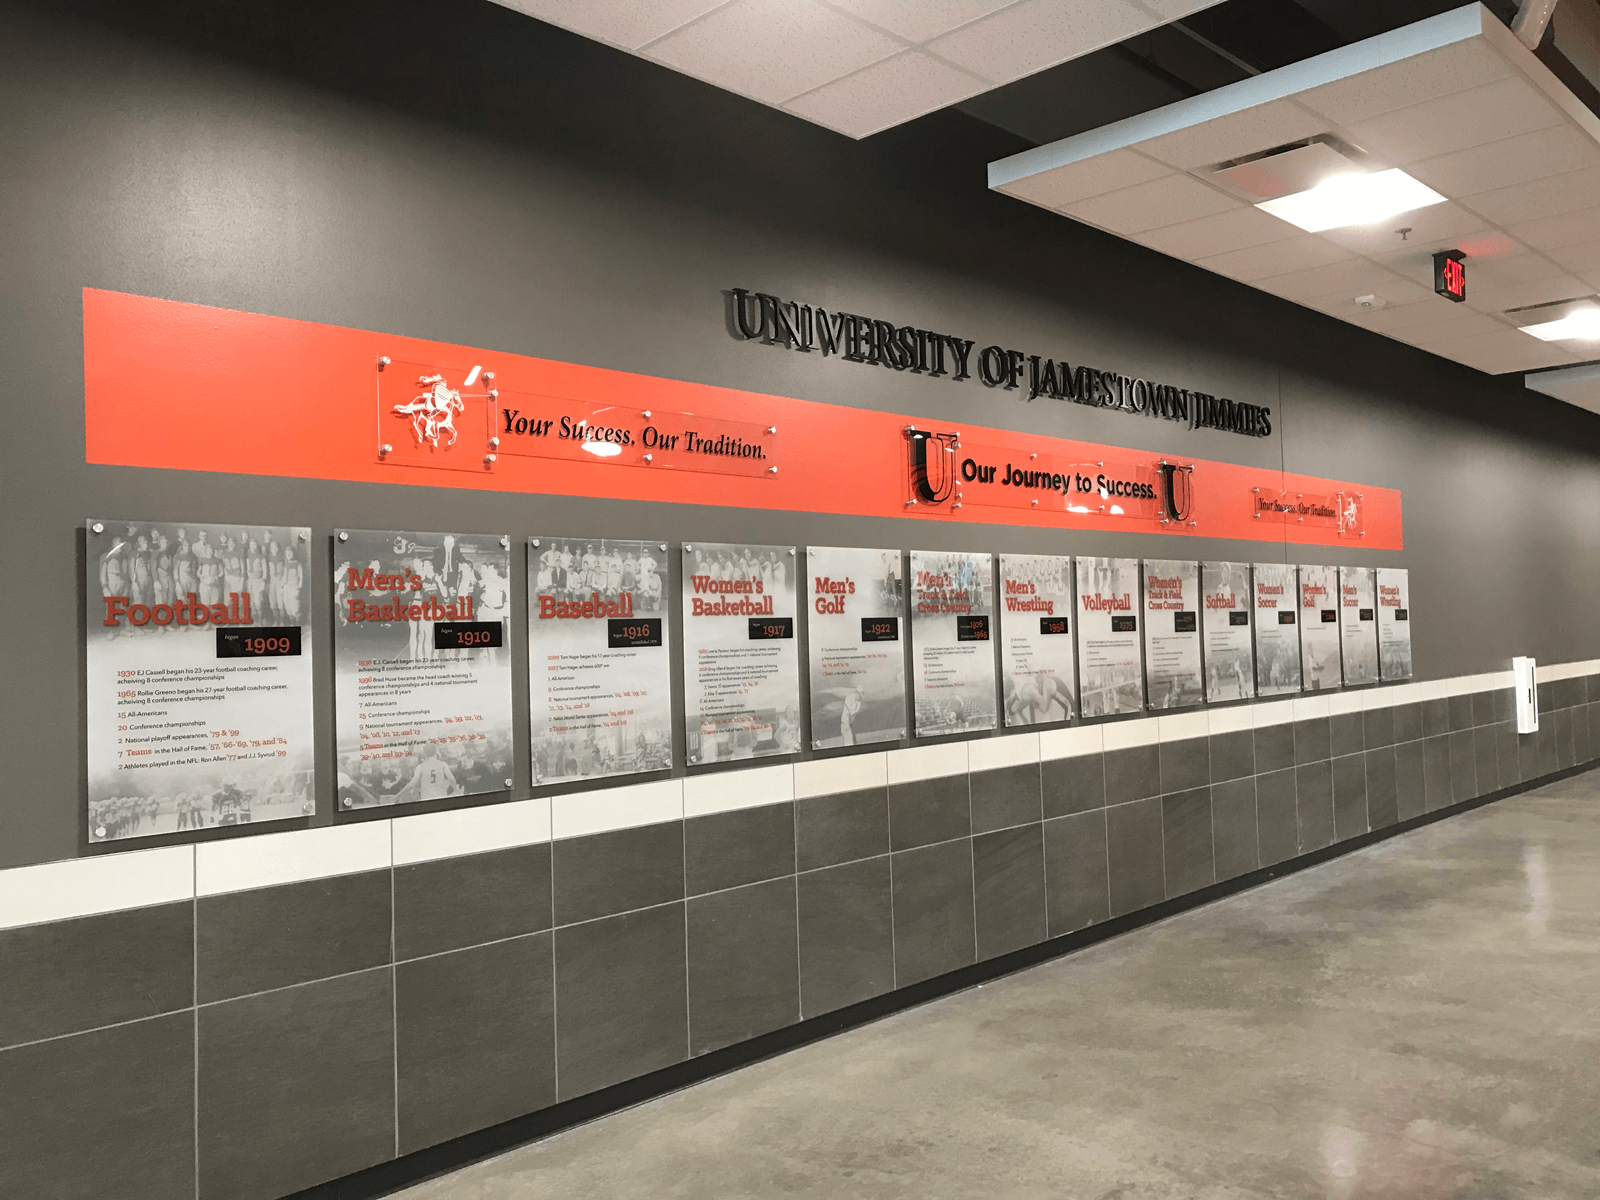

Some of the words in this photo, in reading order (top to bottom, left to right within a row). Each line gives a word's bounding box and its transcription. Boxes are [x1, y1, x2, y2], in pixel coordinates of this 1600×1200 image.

[732, 288, 975, 379] UNIVERSITY
[982, 345, 1024, 388] OF
[1028, 355, 1190, 421] JAMESTOWN
[1194, 391, 1271, 436] JIMMIES
[502, 408, 553, 436] Your
[559, 415, 635, 445] Success.
[642, 426, 679, 450] Our
[684, 430, 767, 459] Tradition.
[910, 429, 957, 502] U
[961, 458, 996, 484] Our
[1002, 463, 1070, 494] Journey
[1076, 471, 1092, 493] to
[1096, 474, 1157, 499] Success.
[1162, 464, 1193, 521] U
[347, 568, 422, 590] Men's
[691, 575, 763, 594] Women's
[815, 577, 855, 594] Men's
[917, 571, 951, 587] Men's
[1006, 580, 1035, 594] Men's
[1148, 576, 1182, 589] Women's
[1257, 583, 1284, 595] Women's
[103, 592, 252, 626] Football
[347, 596, 474, 622] Basketball
[538, 592, 634, 619] Baseball
[692, 595, 773, 616] Basketball
[815, 595, 846, 614] Golf
[1005, 595, 1054, 615] Wrestling
[1082, 593, 1131, 614] Volleyball
[1206, 593, 1236, 609] Softball
[1258, 596, 1277, 608] Soccer
[622, 624, 650, 639] 1916
[763, 625, 785, 637] 1917
[871, 624, 890, 634] 1922
[245, 637, 290, 654] 1909
[457, 631, 490, 645] 1910
[164, 720, 206, 728] championships
[151, 735, 171, 743] playoff
[262, 737, 276, 745] and
[124, 762, 148, 770] Athletes
[149, 761, 169, 769] played
